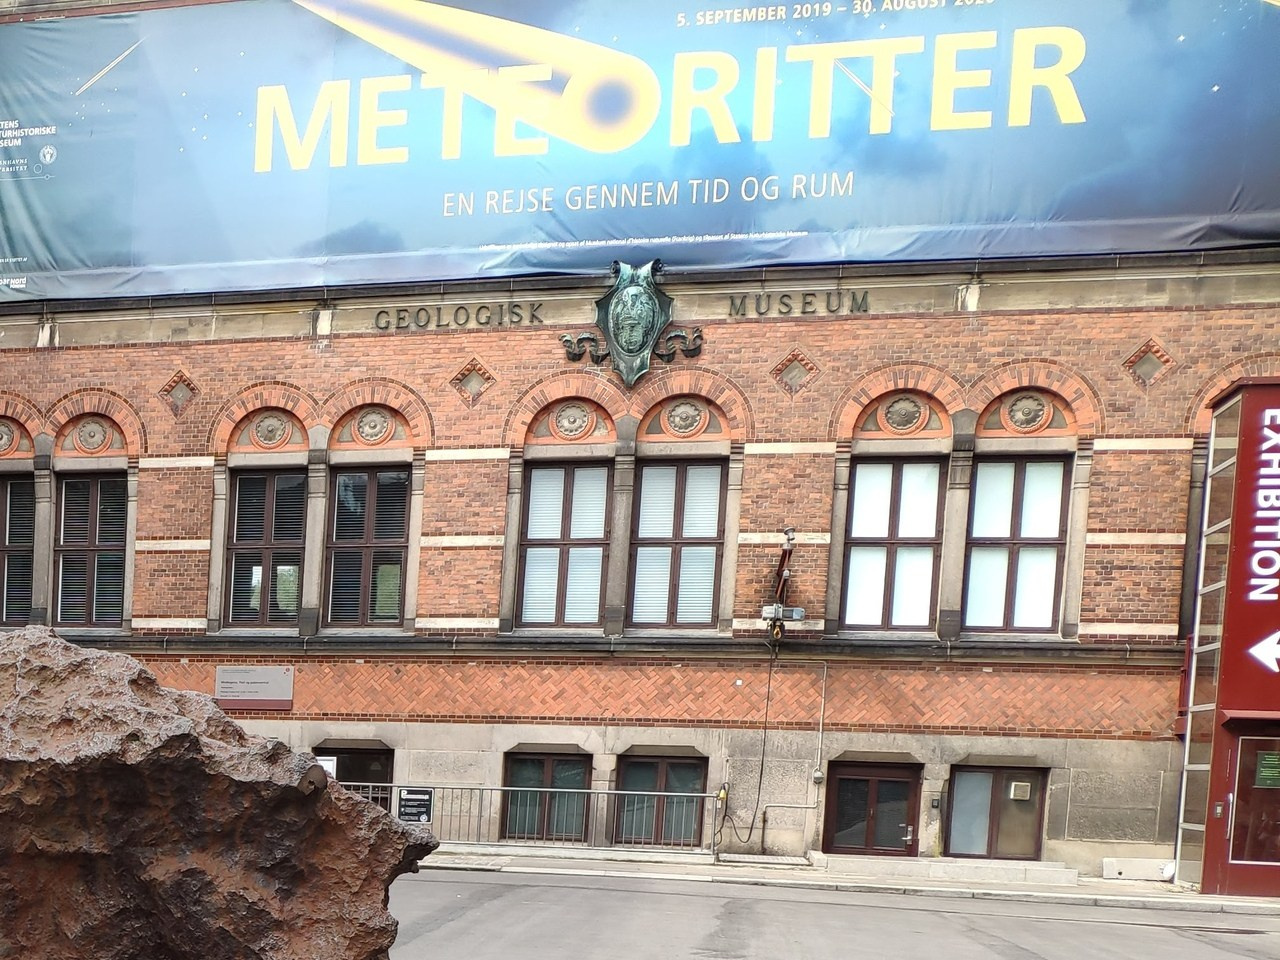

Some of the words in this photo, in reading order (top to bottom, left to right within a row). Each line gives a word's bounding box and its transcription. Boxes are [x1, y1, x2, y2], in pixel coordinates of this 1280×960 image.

[677, 13, 690, 27] 5.
[696, 5, 787, 26] SEPTEMBER
[792, 2, 832, 19] 2019
[853, 0, 877, 14] 30.
[253, 26, 1087, 173] METEORITTER
[443, 191, 474, 217] EN
[485, 187, 554, 214] REJSE
[565, 180, 679, 211] GENNEM
[688, 178, 730, 204] TID
[740, 175, 779, 202] OG
[791, 171, 854, 199] RUM
[374, 303, 544, 330] GEOLOGISK
[728, 290, 869, 316] MUSEUM
[1248, 408, 1280, 601] EXHIBITION
